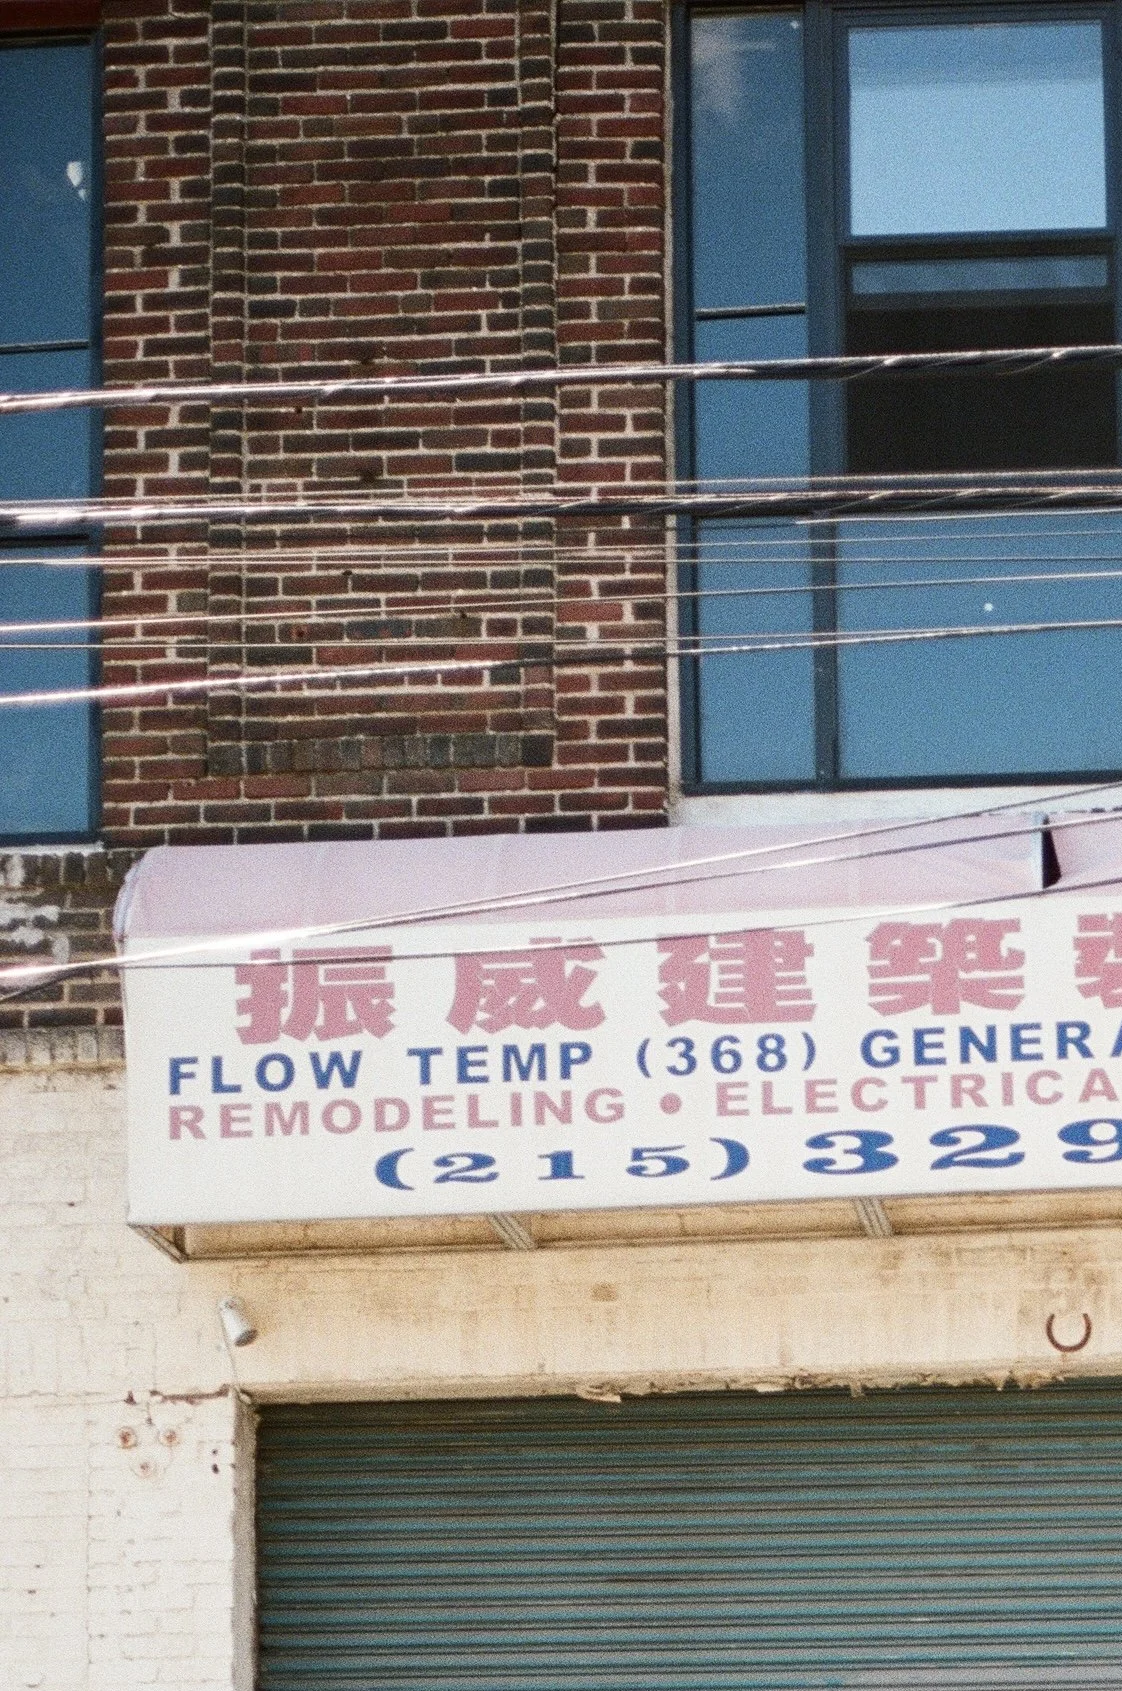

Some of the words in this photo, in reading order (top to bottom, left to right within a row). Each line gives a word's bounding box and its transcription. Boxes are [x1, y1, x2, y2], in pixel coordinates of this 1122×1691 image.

[168, 1053, 363, 1096] FLOW
[408, 1042, 594, 1085] TEMP
[636, 1031, 818, 1080] (368)
[168, 1086, 626, 1140] REMODELING
[373, 1137, 751, 1191] (215)
